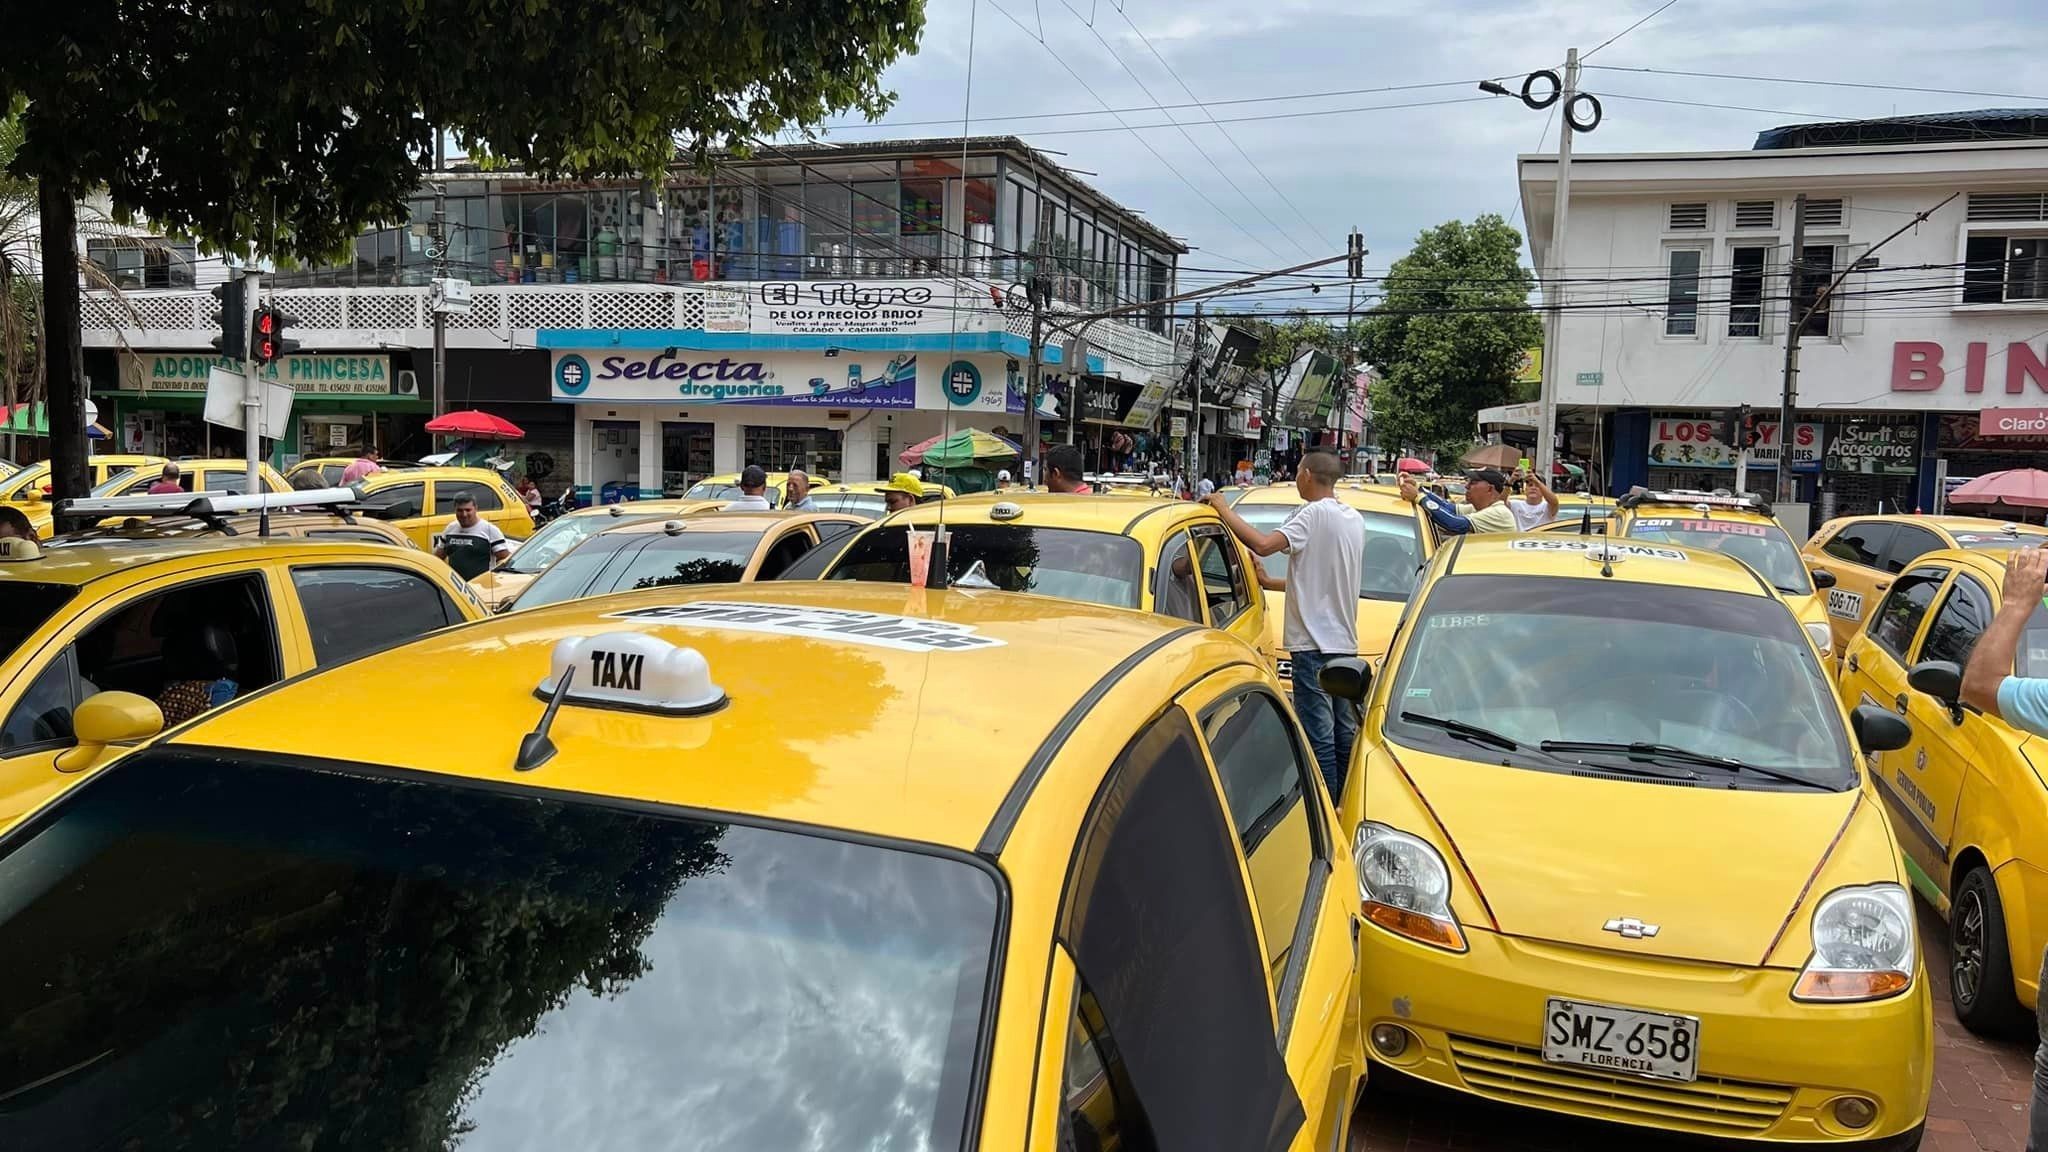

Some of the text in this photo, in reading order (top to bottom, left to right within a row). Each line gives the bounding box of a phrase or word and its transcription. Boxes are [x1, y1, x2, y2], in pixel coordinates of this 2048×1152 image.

[762, 283, 798, 305] El
[811, 283, 932, 310] Tigre
[769, 310, 924, 320] DE LOS PRECIOS BAJOS
[289, 358, 385, 380] PRINCESA
[596, 354, 767, 381] Selecta
[981, 397, 1003, 406] 1965
[1659, 422, 1713, 443] LOS
[2000, 413, 2046, 431] Claro
[1754, 448, 1813, 460] VARIDES
[1827, 436, 1913, 457] Accesorios
[1680, 519, 1766, 537] TURBO
[1828, 591, 1861, 614] SOG 771
[1431, 614, 1489, 628] LIBRE
[591, 650, 645, 691] TAXI
[1551, 1011, 1691, 1063] SMZ 658
[1582, 1052, 1654, 1072] FLORENCIA
